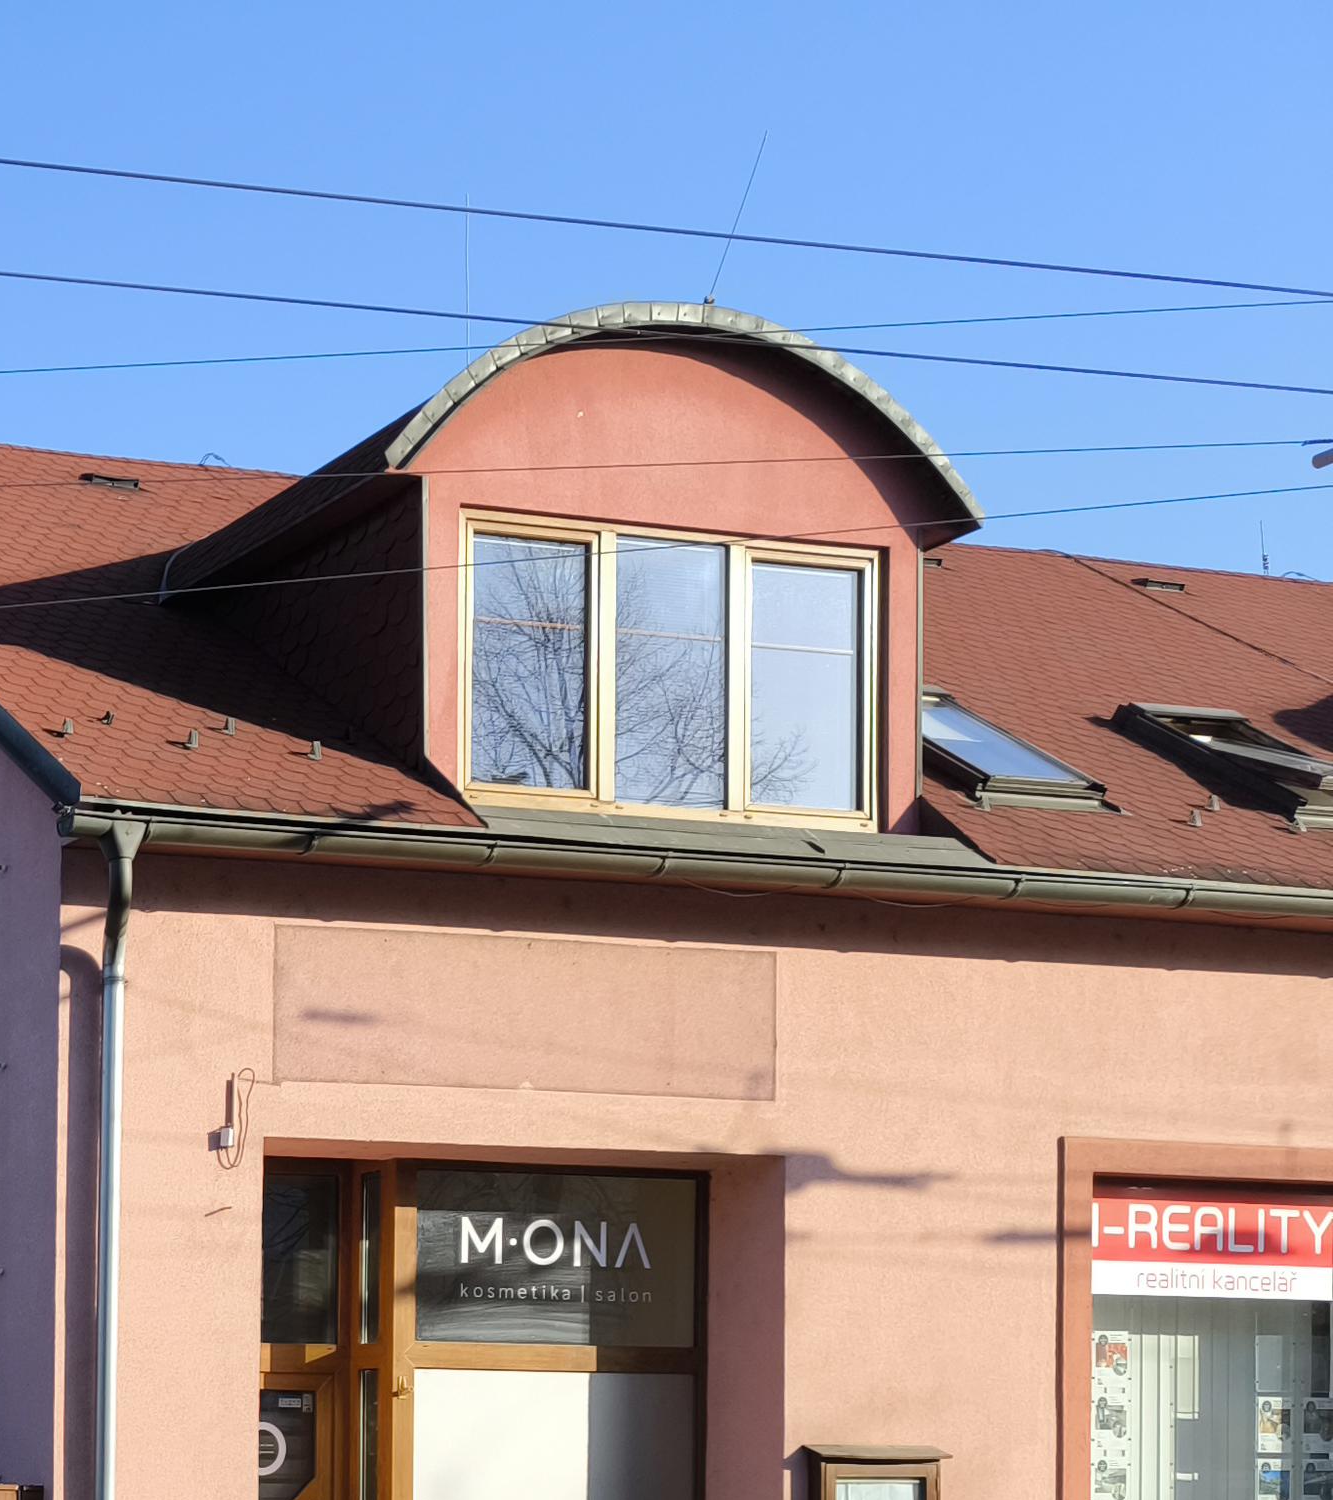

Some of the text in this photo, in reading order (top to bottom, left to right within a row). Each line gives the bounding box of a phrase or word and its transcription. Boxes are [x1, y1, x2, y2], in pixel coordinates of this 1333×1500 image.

[1137, 1268, 1298, 1292] realitní kancelář
[460, 1283, 572, 1300] kosmetika
[595, 1288, 652, 1303] salon
